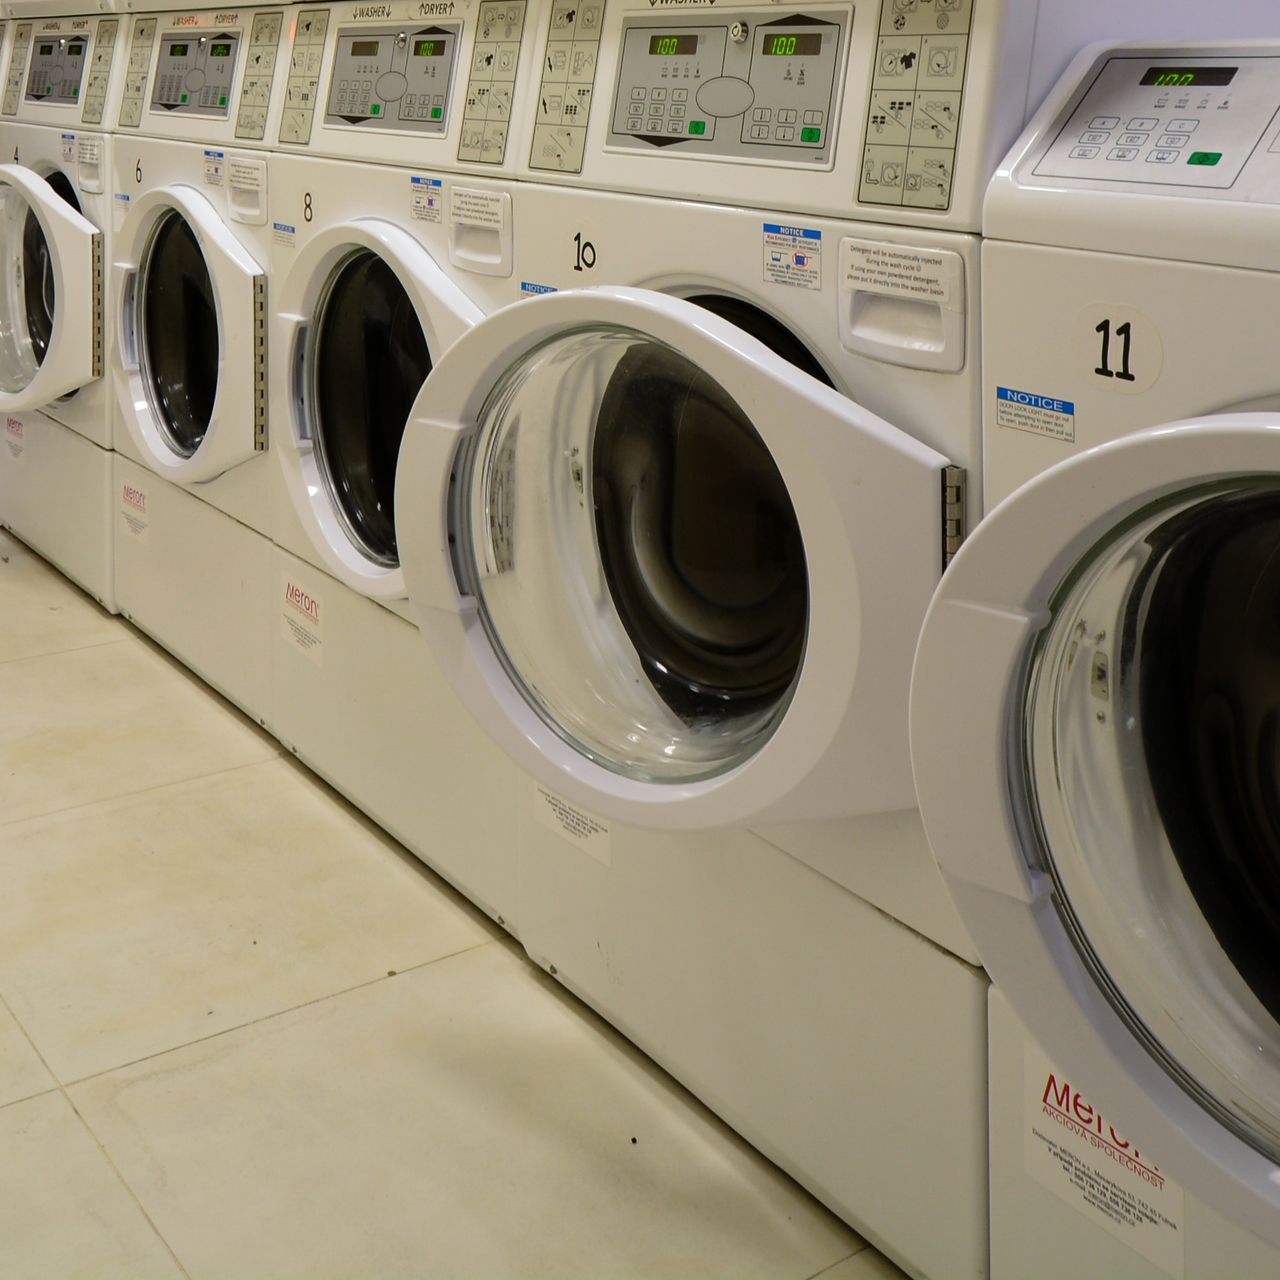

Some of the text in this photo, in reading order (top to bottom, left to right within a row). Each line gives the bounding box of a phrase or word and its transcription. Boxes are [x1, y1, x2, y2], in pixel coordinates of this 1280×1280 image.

[359, 6, 385, 18] WASHER
[425, 3, 447, 15] DRYER
[657, 38, 677, 54] 100
[772, 37, 796, 55] 100
[136, 159, 142, 183] 6
[304, 192, 313, 222] 8
[851, 245, 871, 255] Detergent
[1094, 319, 1136, 382] 11
[1007, 391, 1063, 412] NOTICE
[286, 582, 318, 619] Meron
